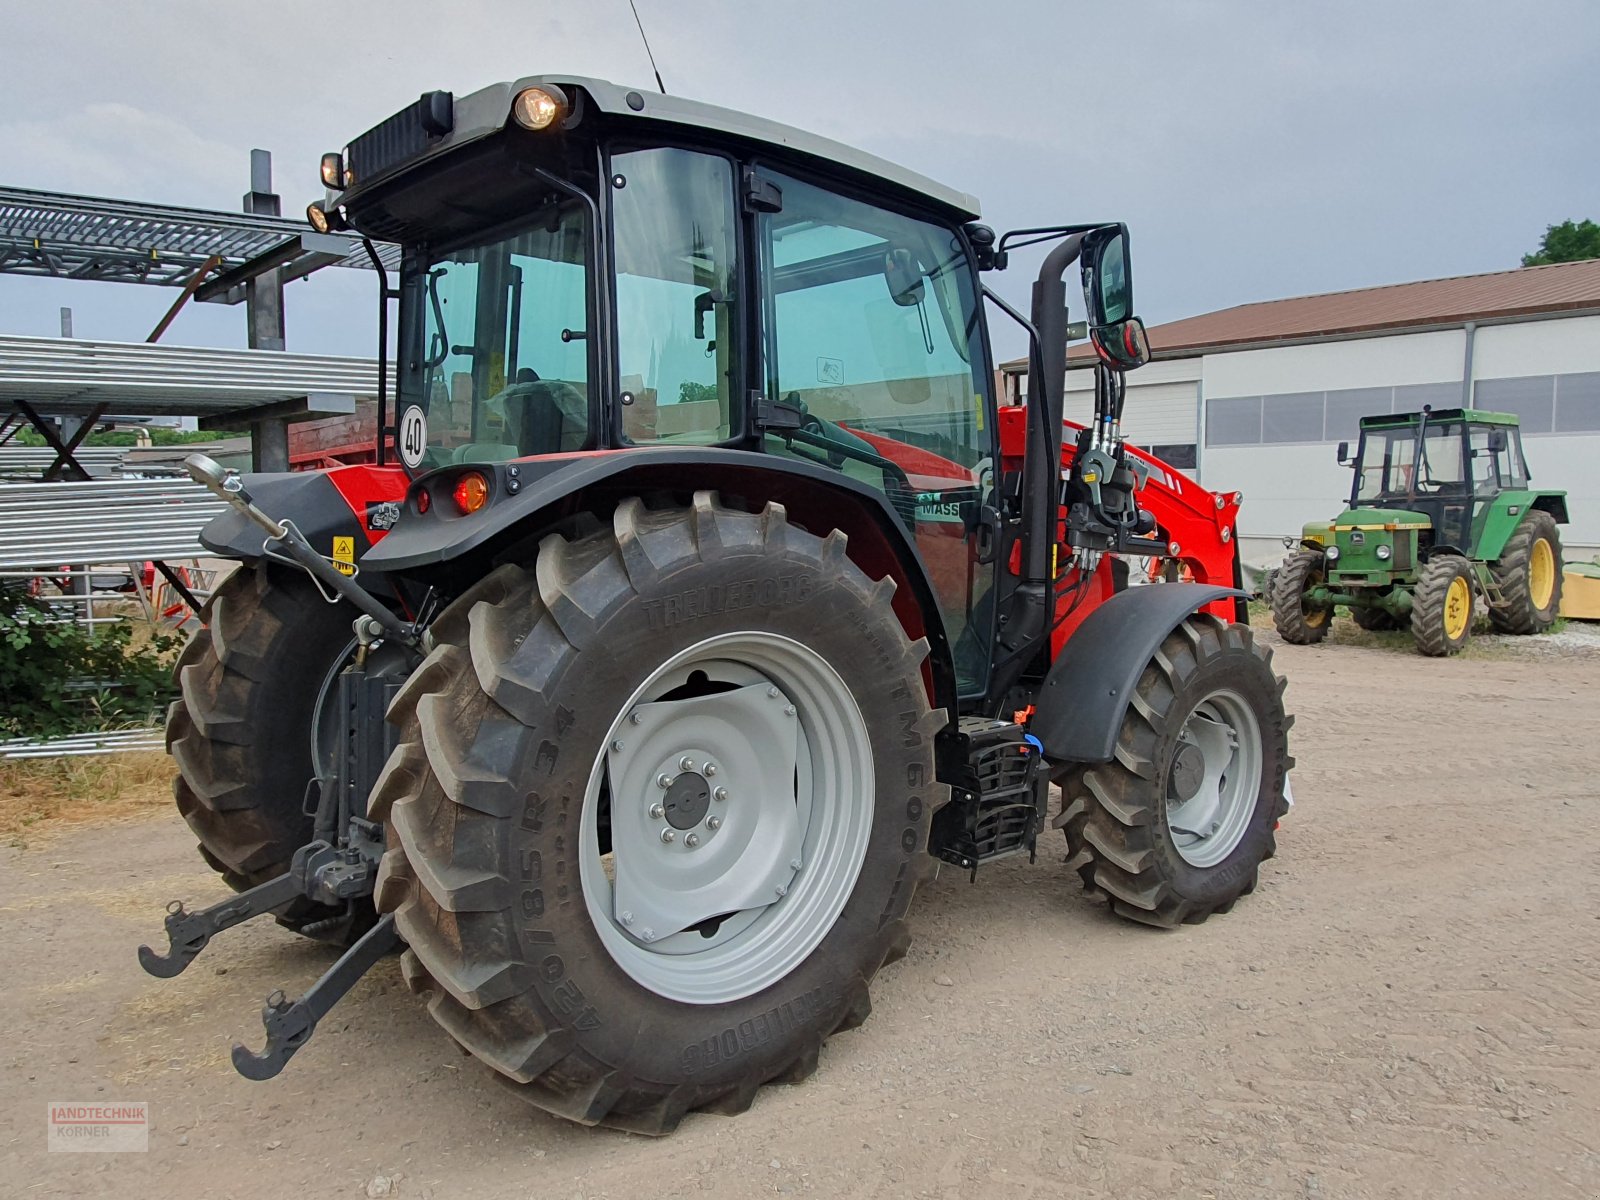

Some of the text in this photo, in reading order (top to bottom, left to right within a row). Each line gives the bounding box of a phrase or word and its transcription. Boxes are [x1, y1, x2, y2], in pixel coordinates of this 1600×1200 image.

[406, 418, 421, 455] 40
[641, 574, 813, 630] TRELLEBORG
[890, 676, 925, 853] TM 600
